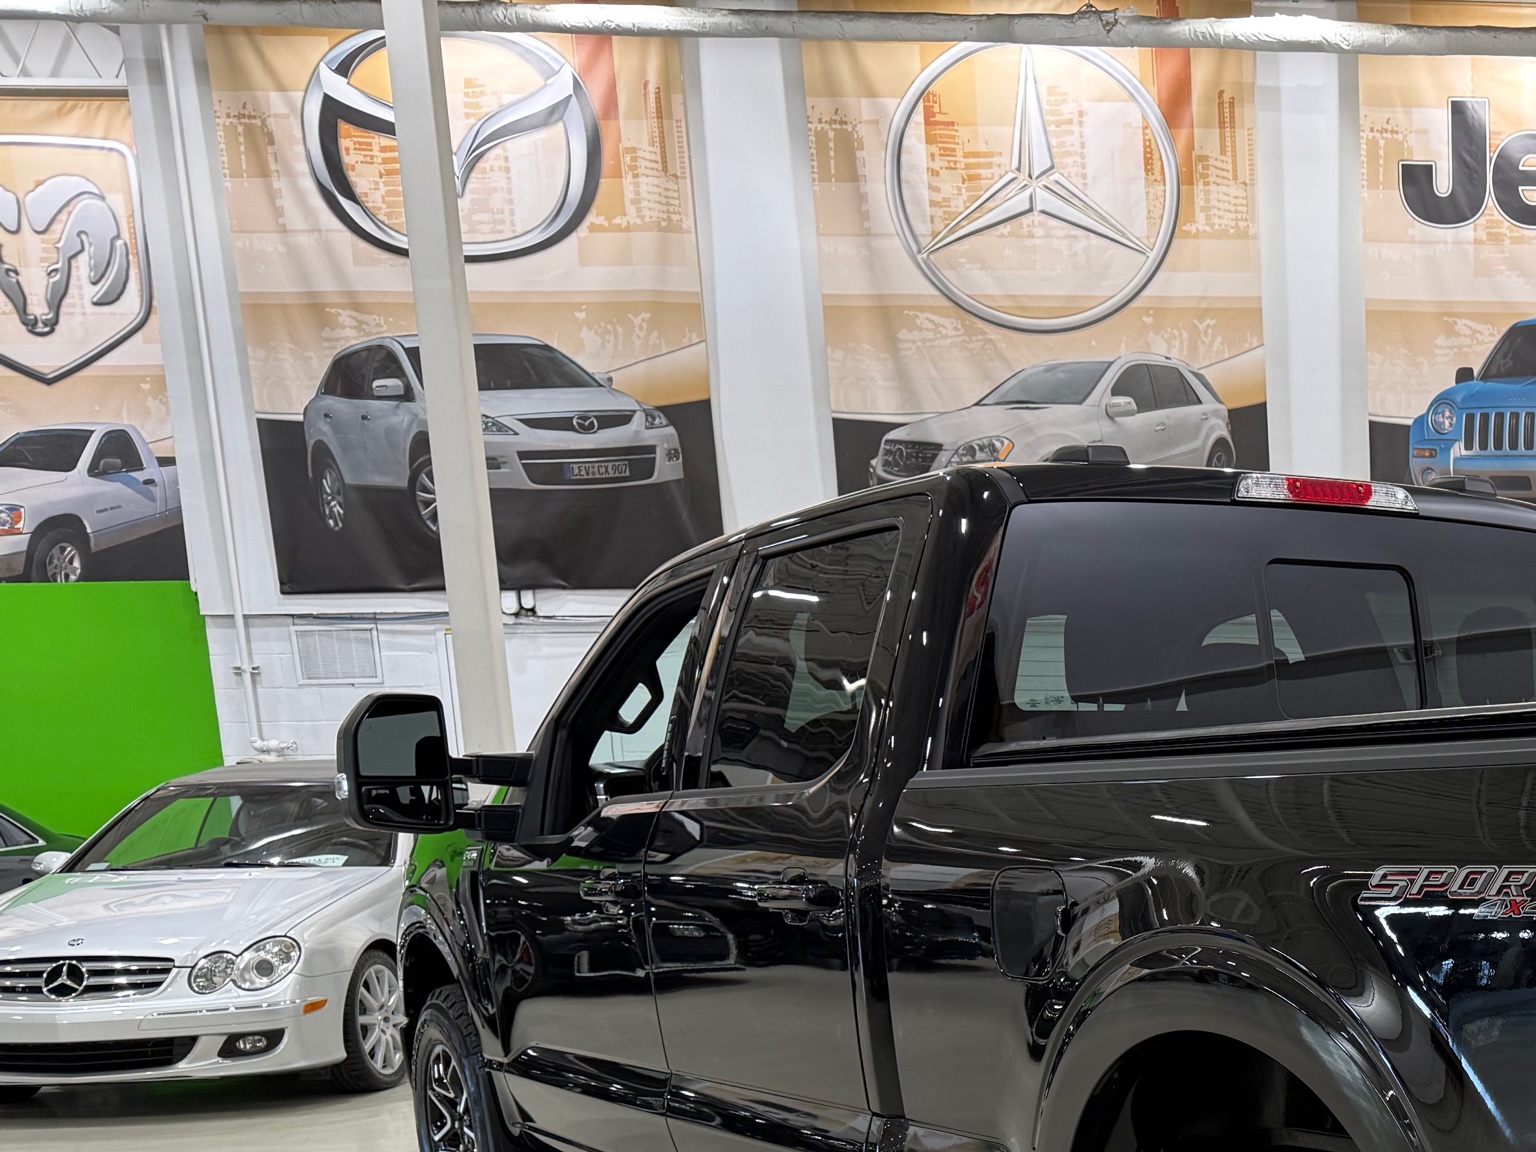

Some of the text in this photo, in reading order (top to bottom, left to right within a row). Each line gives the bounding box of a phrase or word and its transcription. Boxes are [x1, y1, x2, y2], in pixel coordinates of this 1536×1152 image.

[571, 463, 628, 477] LEV CX 907
